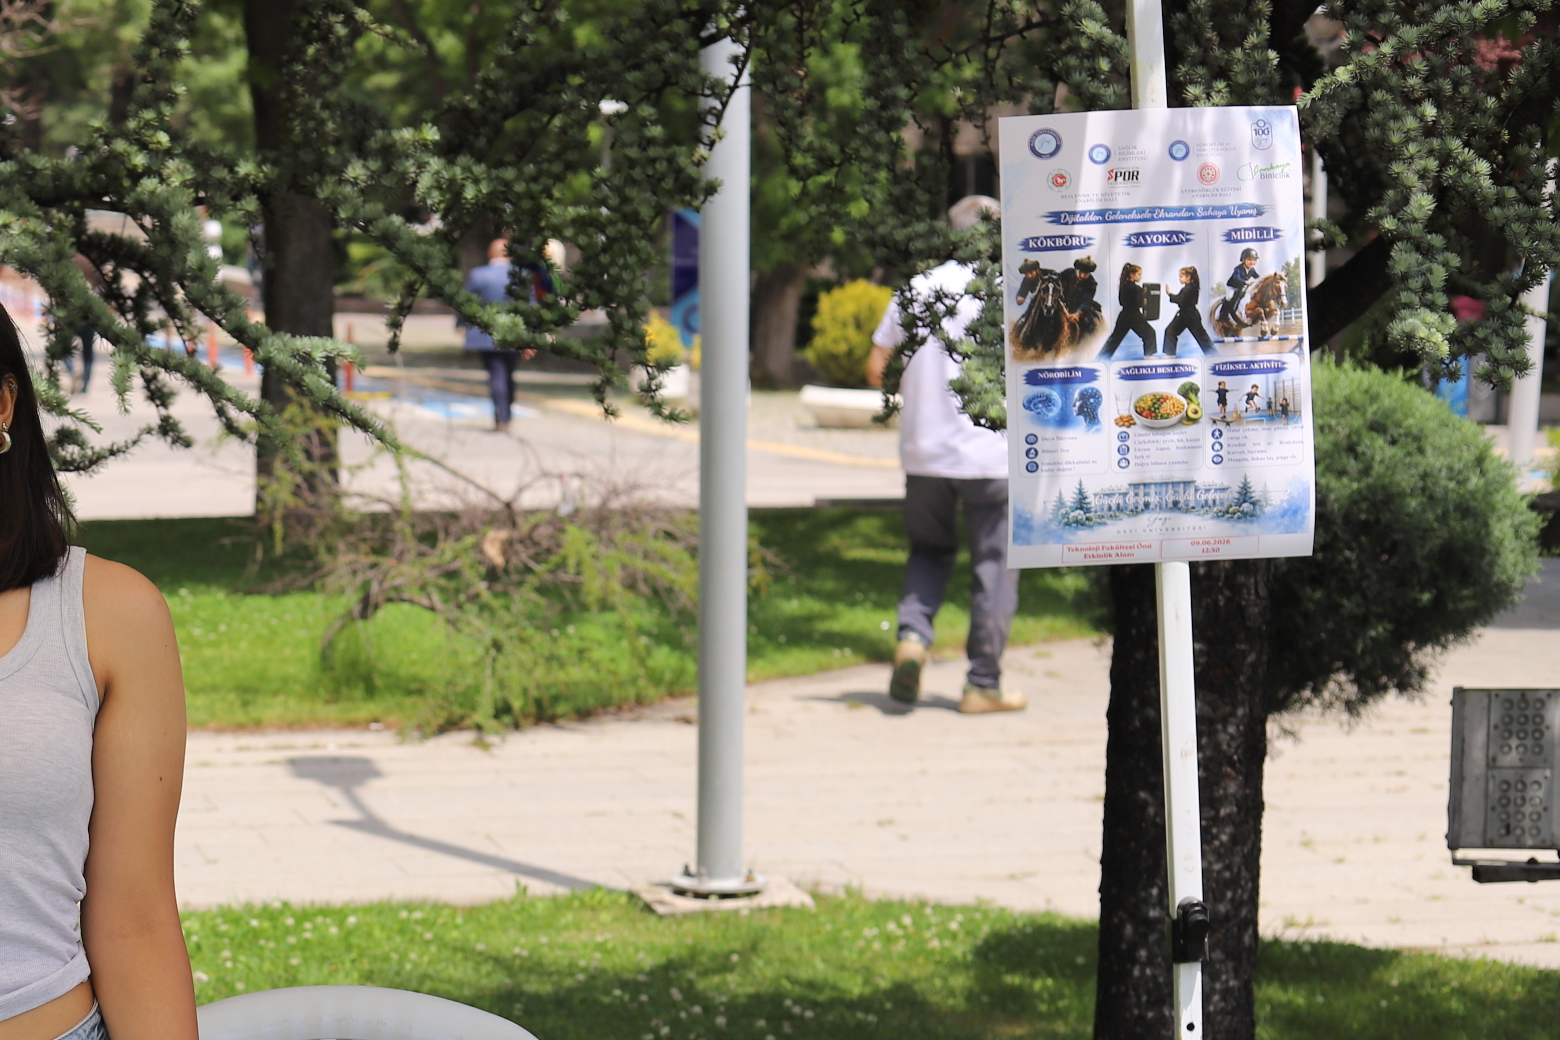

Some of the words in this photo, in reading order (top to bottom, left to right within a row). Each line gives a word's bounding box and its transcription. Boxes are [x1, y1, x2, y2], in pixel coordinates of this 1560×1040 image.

[1260, 172, 1290, 180] Binicilik
[1060, 212, 1103, 224] Dijitalden
[1105, 210, 1152, 222] Geleneksele
[1153, 208, 1194, 220] Ekrandan
[1196, 206, 1227, 218] Sahaya
[1228, 206, 1258, 218] Uyanış
[1231, 228, 1274, 240] MİDİLLİ
[1028, 235, 1088, 248] KÖKBÖRÜ
[1130, 233, 1187, 246] SAYOKAN
[1120, 366, 1156, 376] SAĞLIKLI
[1215, 362, 1247, 372] FİZİKSEL
[1038, 370, 1082, 380] NÖROBİLİM
[1190, 538, 1230, 546] 09.06.2026
[1067, 545, 1100, 554] Teknoloji
[1101, 544, 1136, 552] Fakültesi
[1136, 542, 1152, 550] Önü
[1084, 552, 1113, 560] Etkinlik
